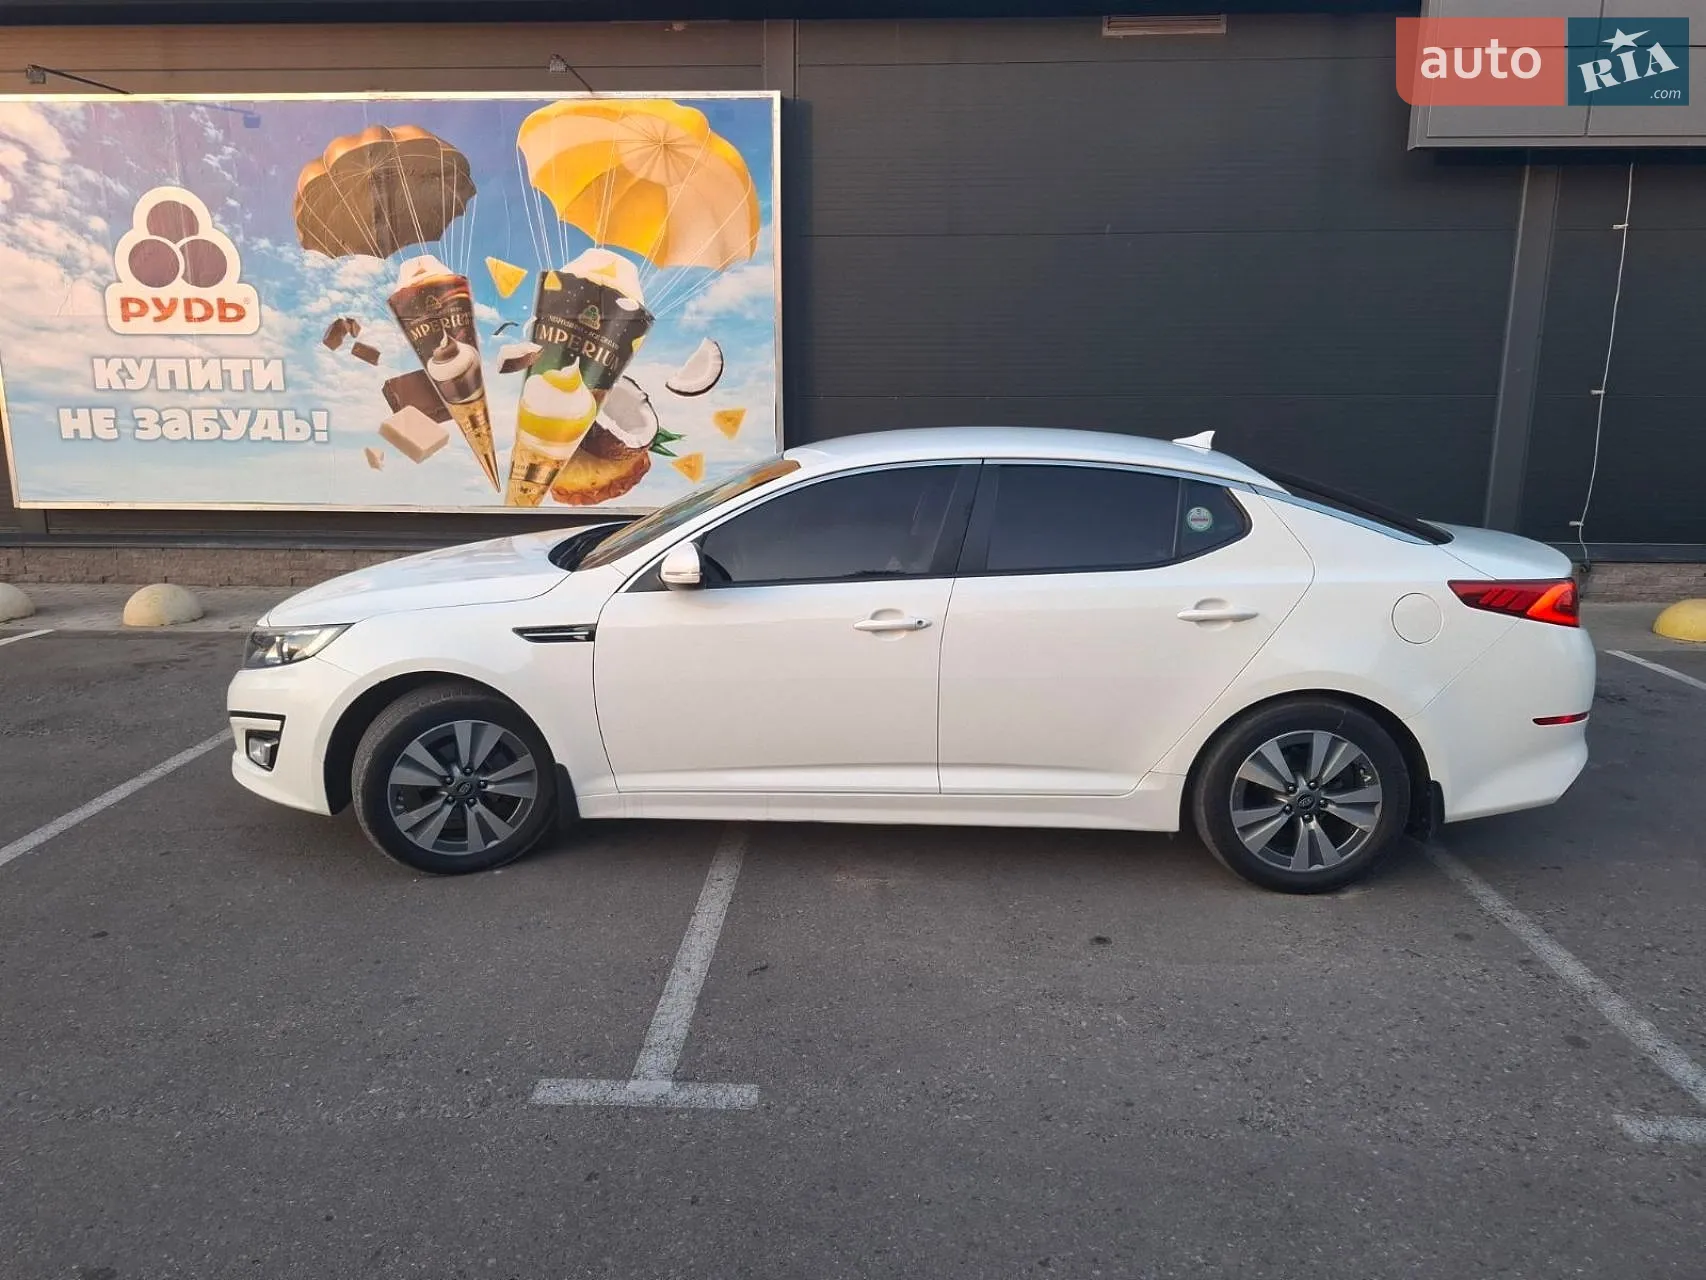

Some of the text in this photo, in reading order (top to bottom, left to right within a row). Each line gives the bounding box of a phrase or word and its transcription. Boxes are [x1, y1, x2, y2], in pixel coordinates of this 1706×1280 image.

[119, 296, 247, 323] РУДЬ
[92, 357, 286, 392] КУПИТИ
[58, 407, 119, 440] НЕ
